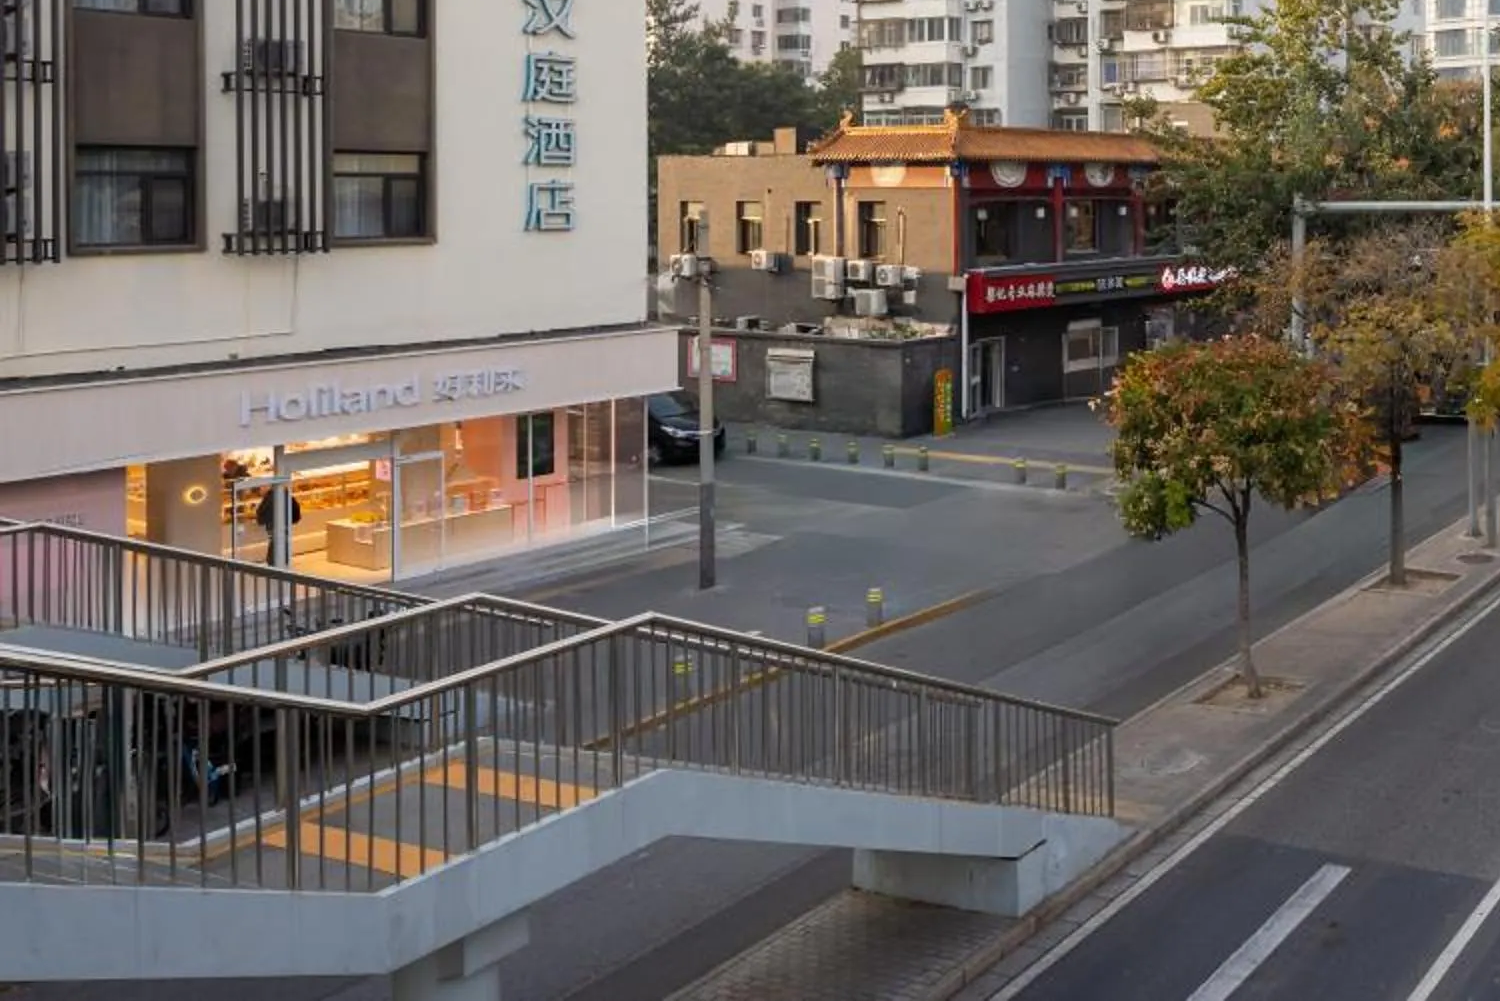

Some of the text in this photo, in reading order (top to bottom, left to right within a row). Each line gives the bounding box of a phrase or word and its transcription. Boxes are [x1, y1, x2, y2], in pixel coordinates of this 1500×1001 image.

[238, 369, 523, 428] Holiland 好利来
